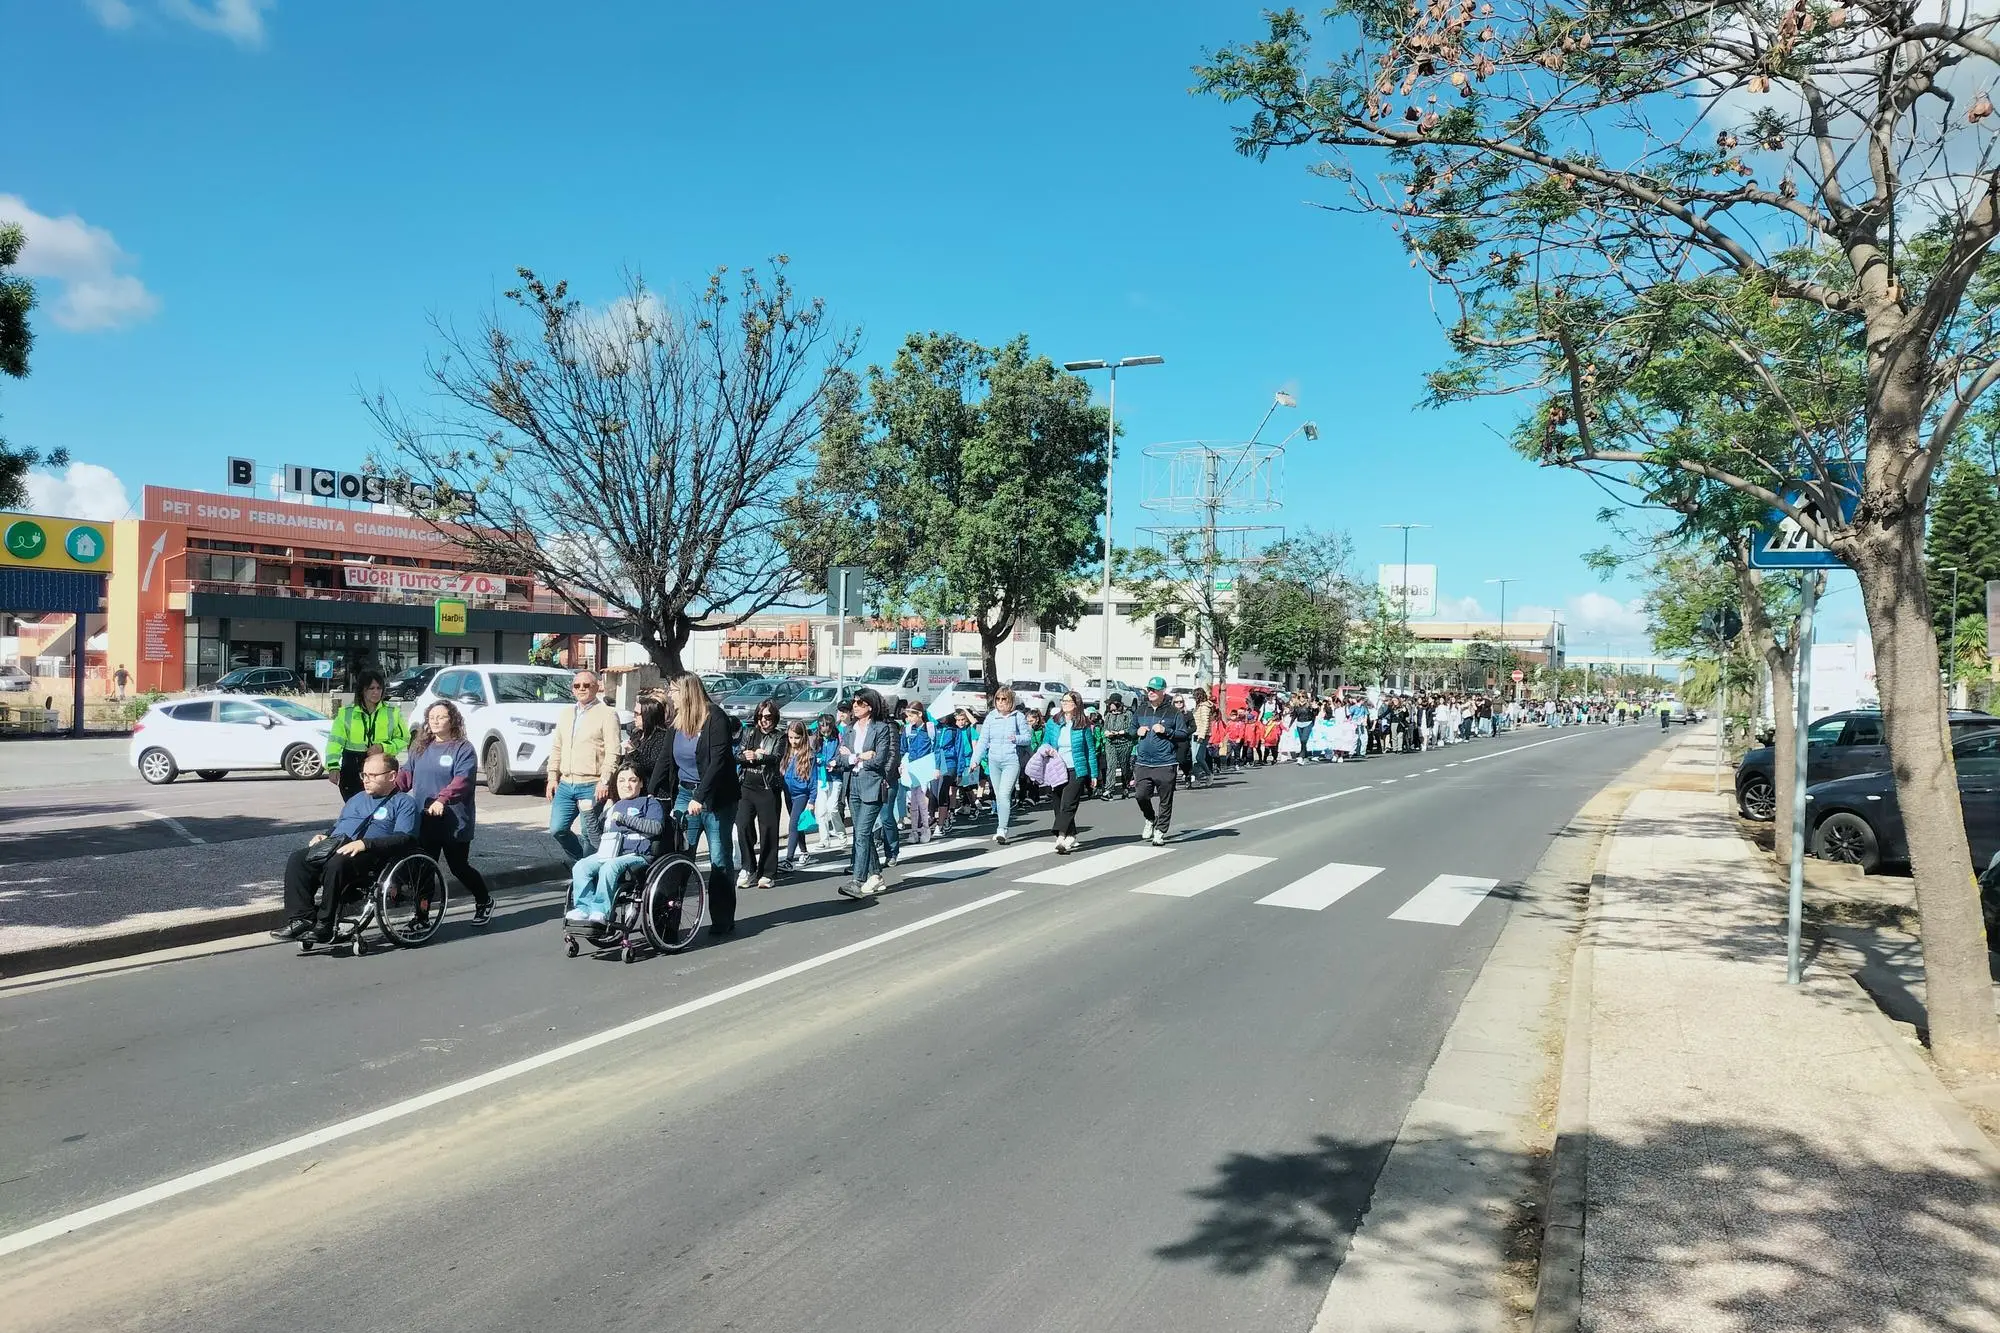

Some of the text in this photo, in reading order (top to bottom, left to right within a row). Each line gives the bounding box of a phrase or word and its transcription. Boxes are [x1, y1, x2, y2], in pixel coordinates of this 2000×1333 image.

[163, 500, 191, 516] PET
[198, 504, 241, 520] SHOP
[249, 510, 346, 532] FERRAMENTA
[350, 569, 393, 586] FUORI
[398, 572, 441, 590] TUTTO
[441, 613, 465, 622] HarDis
[318, 661, 331, 677] P
